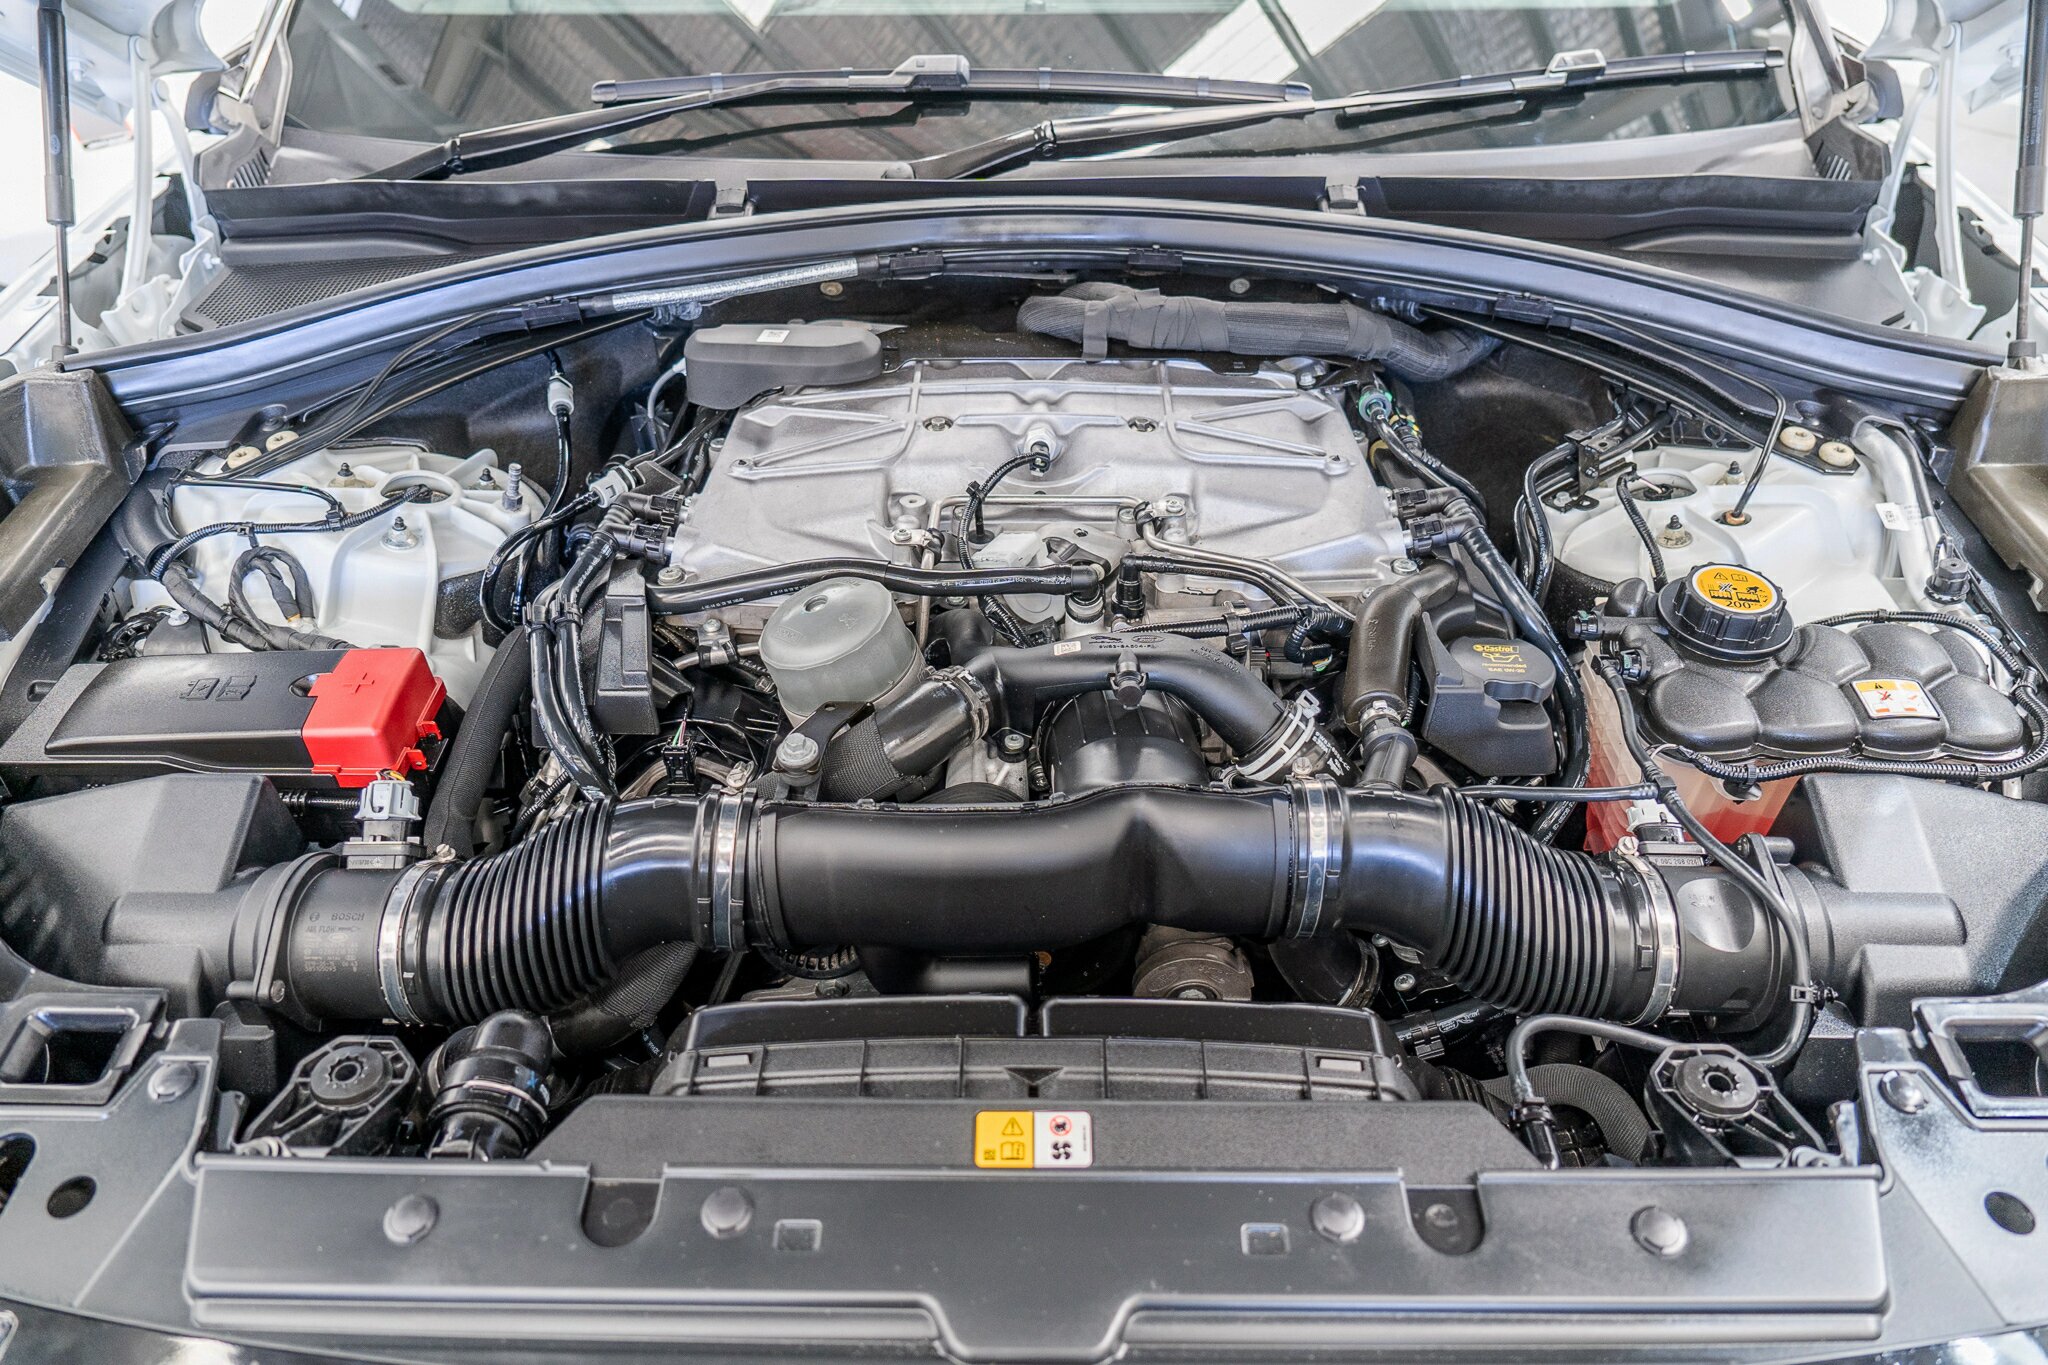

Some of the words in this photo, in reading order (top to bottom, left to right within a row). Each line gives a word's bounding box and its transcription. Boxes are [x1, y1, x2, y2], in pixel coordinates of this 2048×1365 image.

[1726, 601, 1751, 609] 200
[1484, 645, 1513, 653] Castrol
[331, 912, 365, 921] BOSCH
